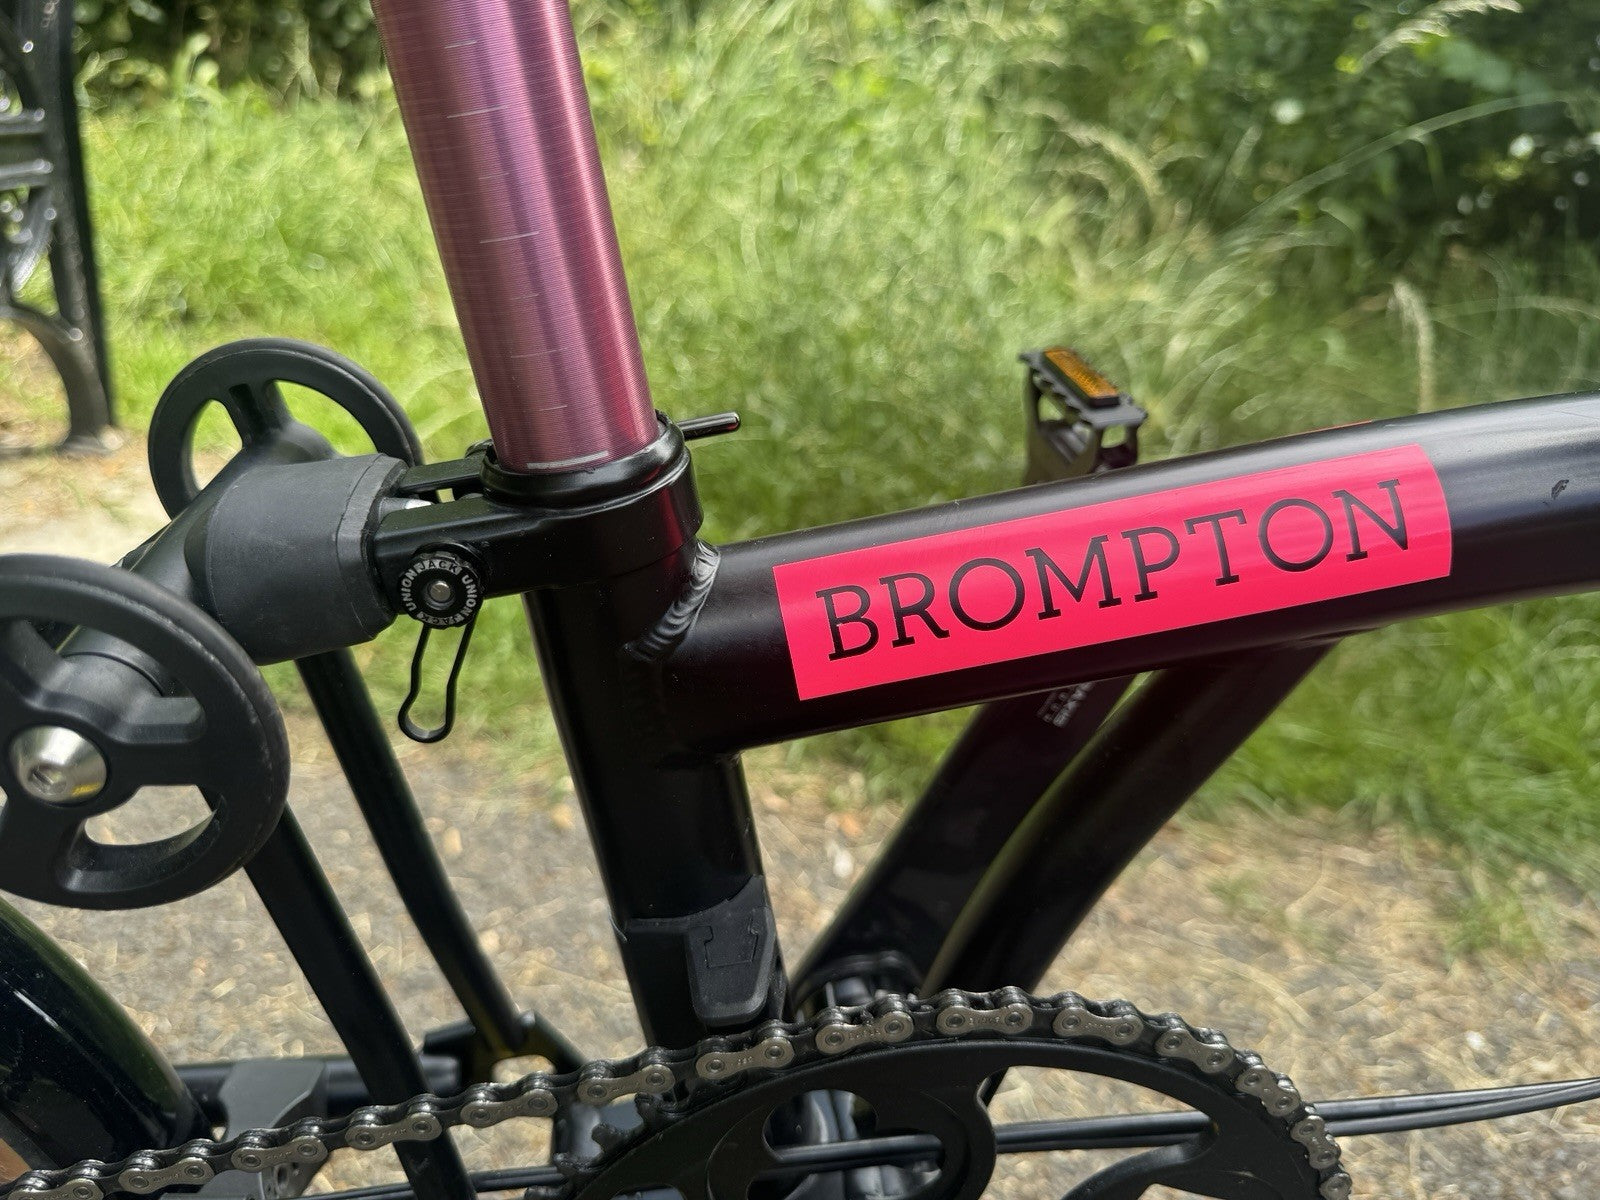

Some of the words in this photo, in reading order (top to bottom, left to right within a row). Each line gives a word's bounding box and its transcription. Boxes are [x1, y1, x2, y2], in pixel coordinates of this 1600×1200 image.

[401, 568, 418, 611] UNION
[417, 559, 461, 575] JACK
[461, 574, 478, 617] UNION
[815, 479, 1409, 661] BROMPTON
